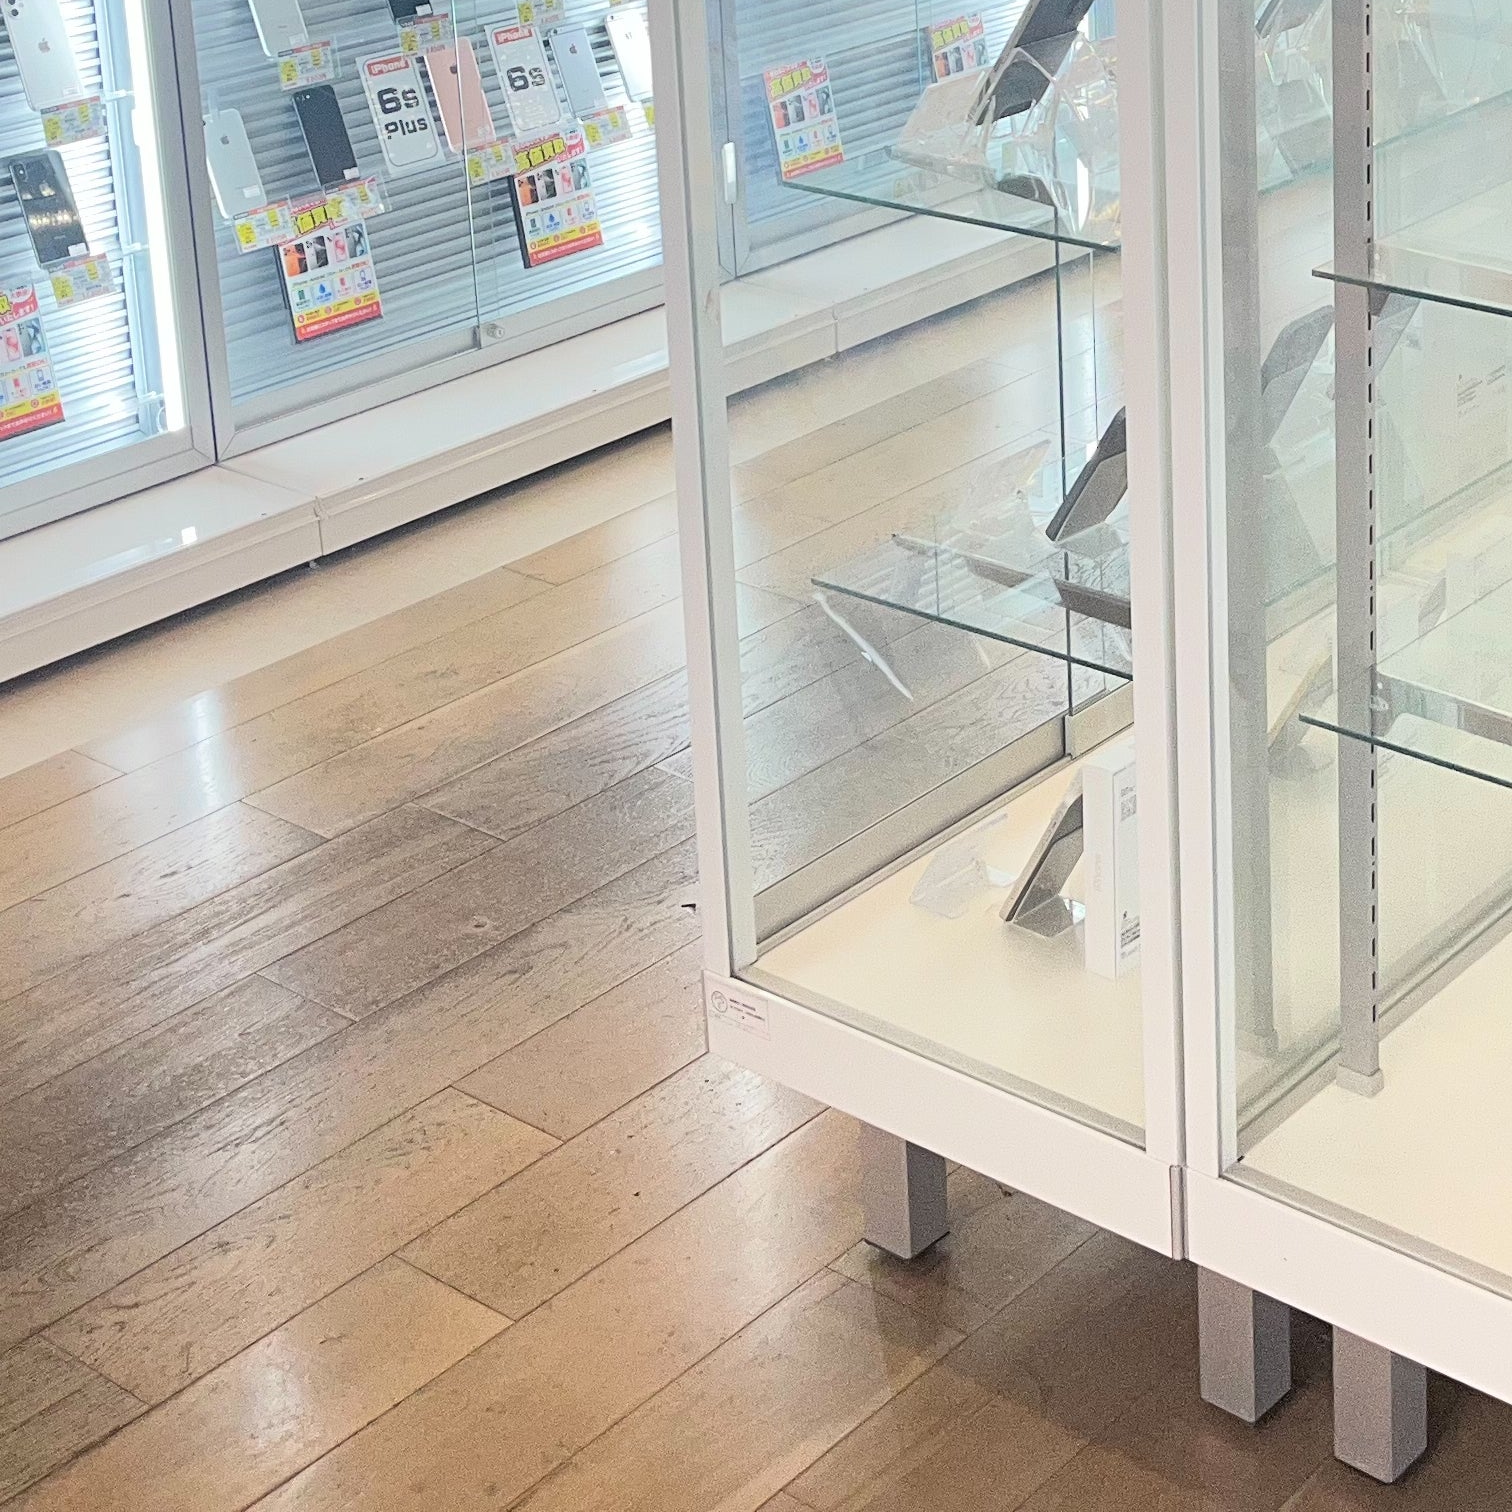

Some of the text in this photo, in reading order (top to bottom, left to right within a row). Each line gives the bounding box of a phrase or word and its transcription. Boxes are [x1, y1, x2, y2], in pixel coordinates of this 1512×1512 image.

[496, 28, 533, 44] iPhone
[506, 66, 546, 92] 6s
[377, 87, 421, 115] 6s
